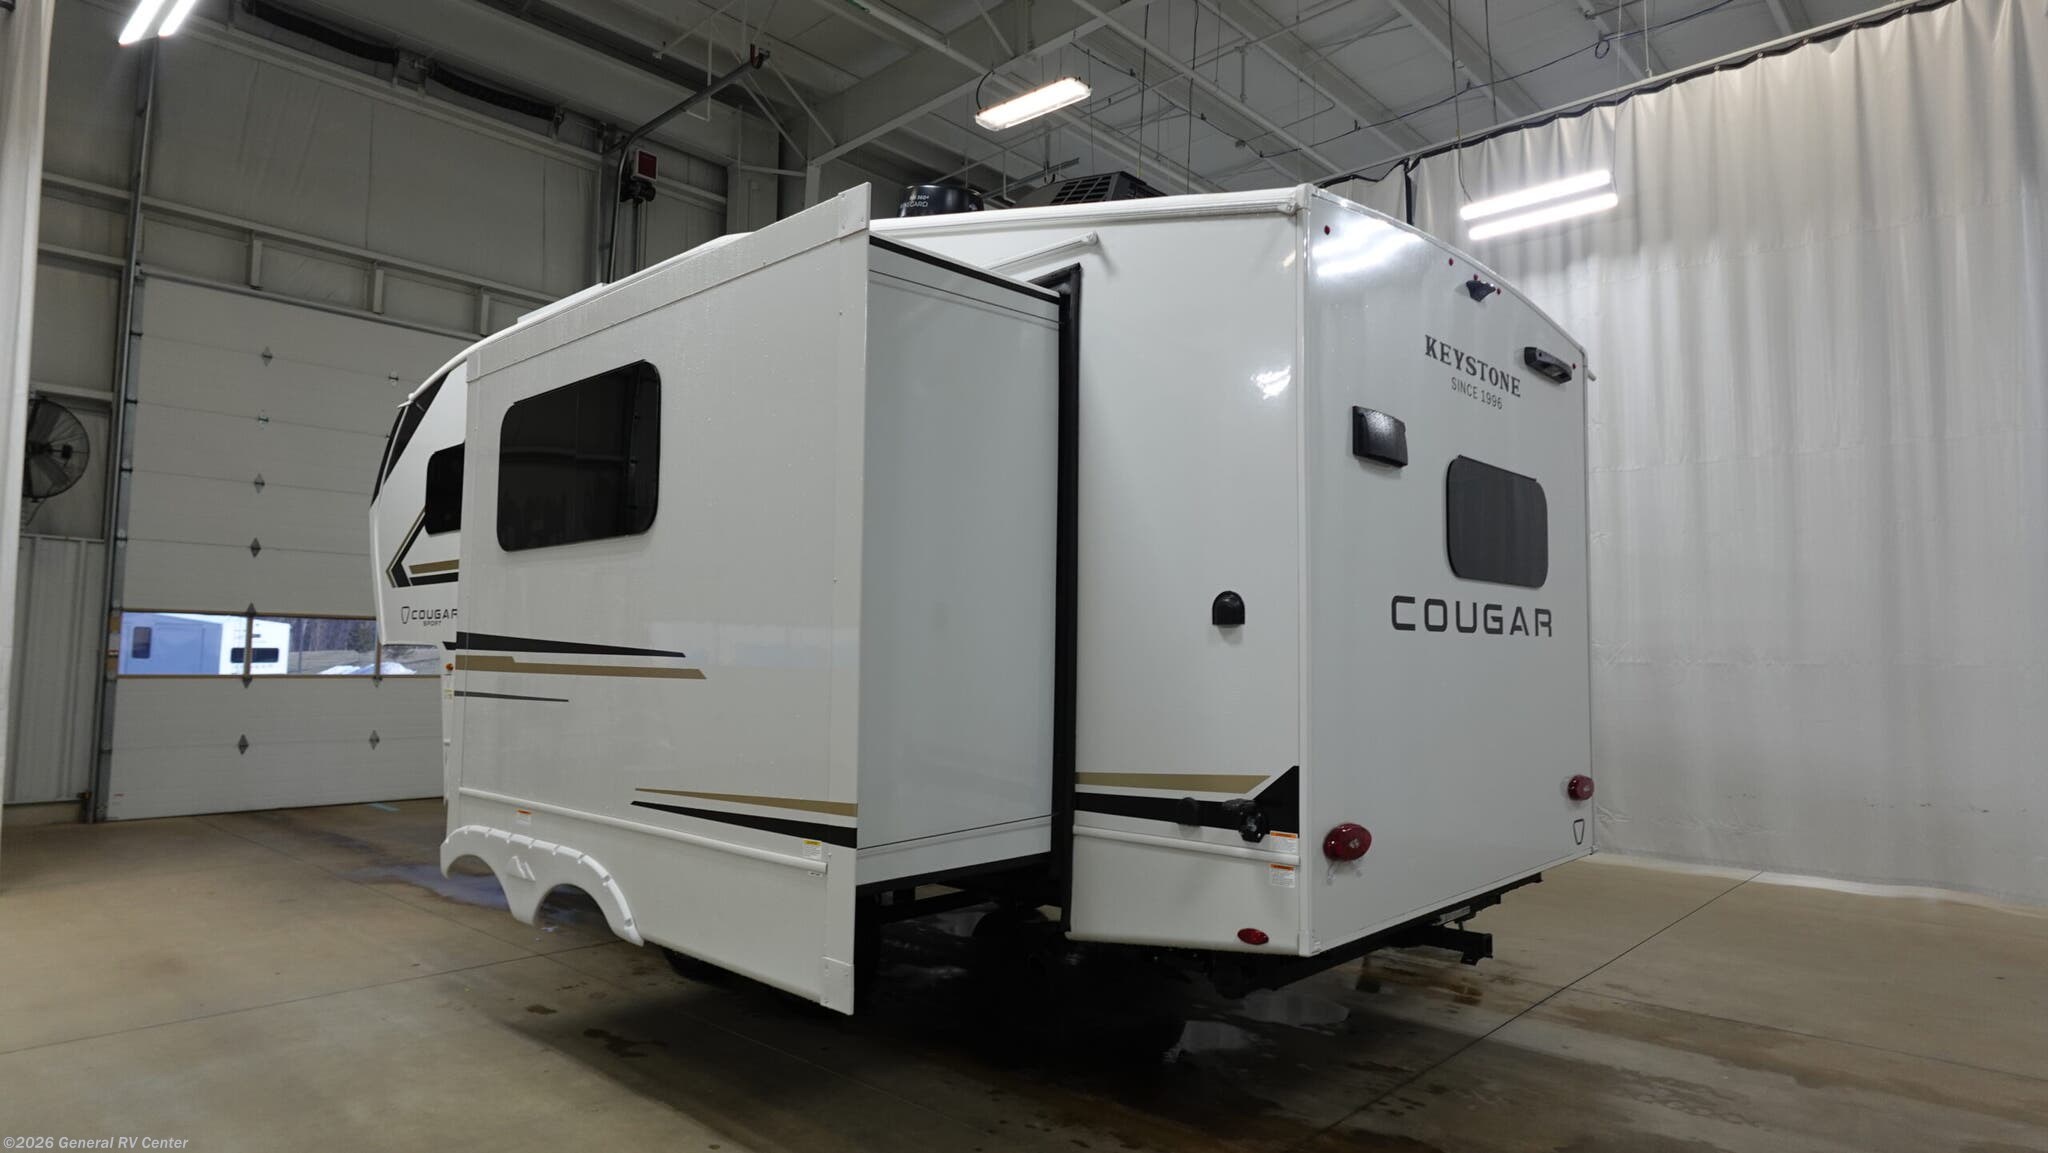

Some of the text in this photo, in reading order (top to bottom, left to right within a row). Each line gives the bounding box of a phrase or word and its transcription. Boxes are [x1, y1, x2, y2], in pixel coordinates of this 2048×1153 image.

[1425, 334, 1521, 398] KEYSTONE
[1451, 377, 1503, 410] SINCE 1996
[1391, 595, 1553, 638] COUGAR
